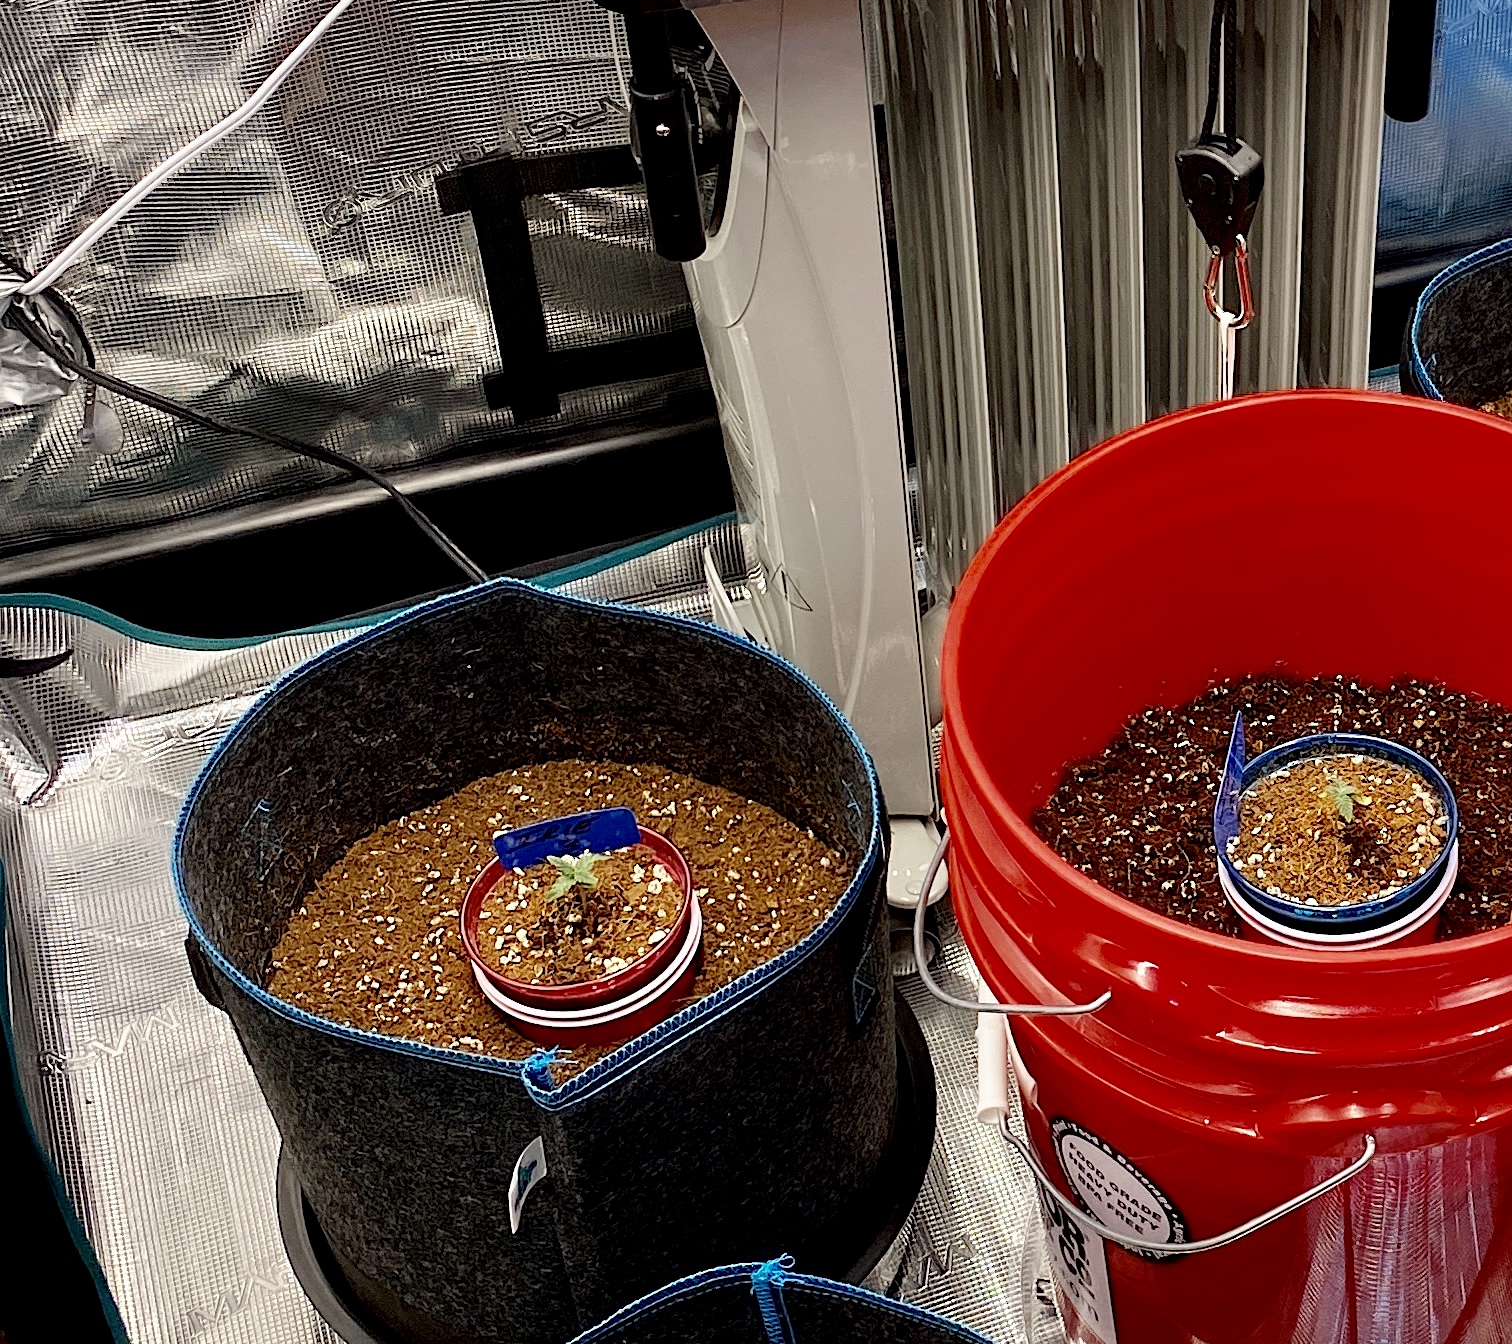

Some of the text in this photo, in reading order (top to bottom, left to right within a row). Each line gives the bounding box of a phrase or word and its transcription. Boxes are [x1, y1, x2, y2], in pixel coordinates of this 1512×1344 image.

[1069, 1142, 1105, 1180] FOOD
[1109, 1181, 1163, 1223] GRADE
[1069, 1152, 1112, 1196] HEAVY
[1117, 1198, 1160, 1231] DUTY
[1078, 1173, 1103, 1202] BPA
[1107, 1202, 1145, 1235] FREE
